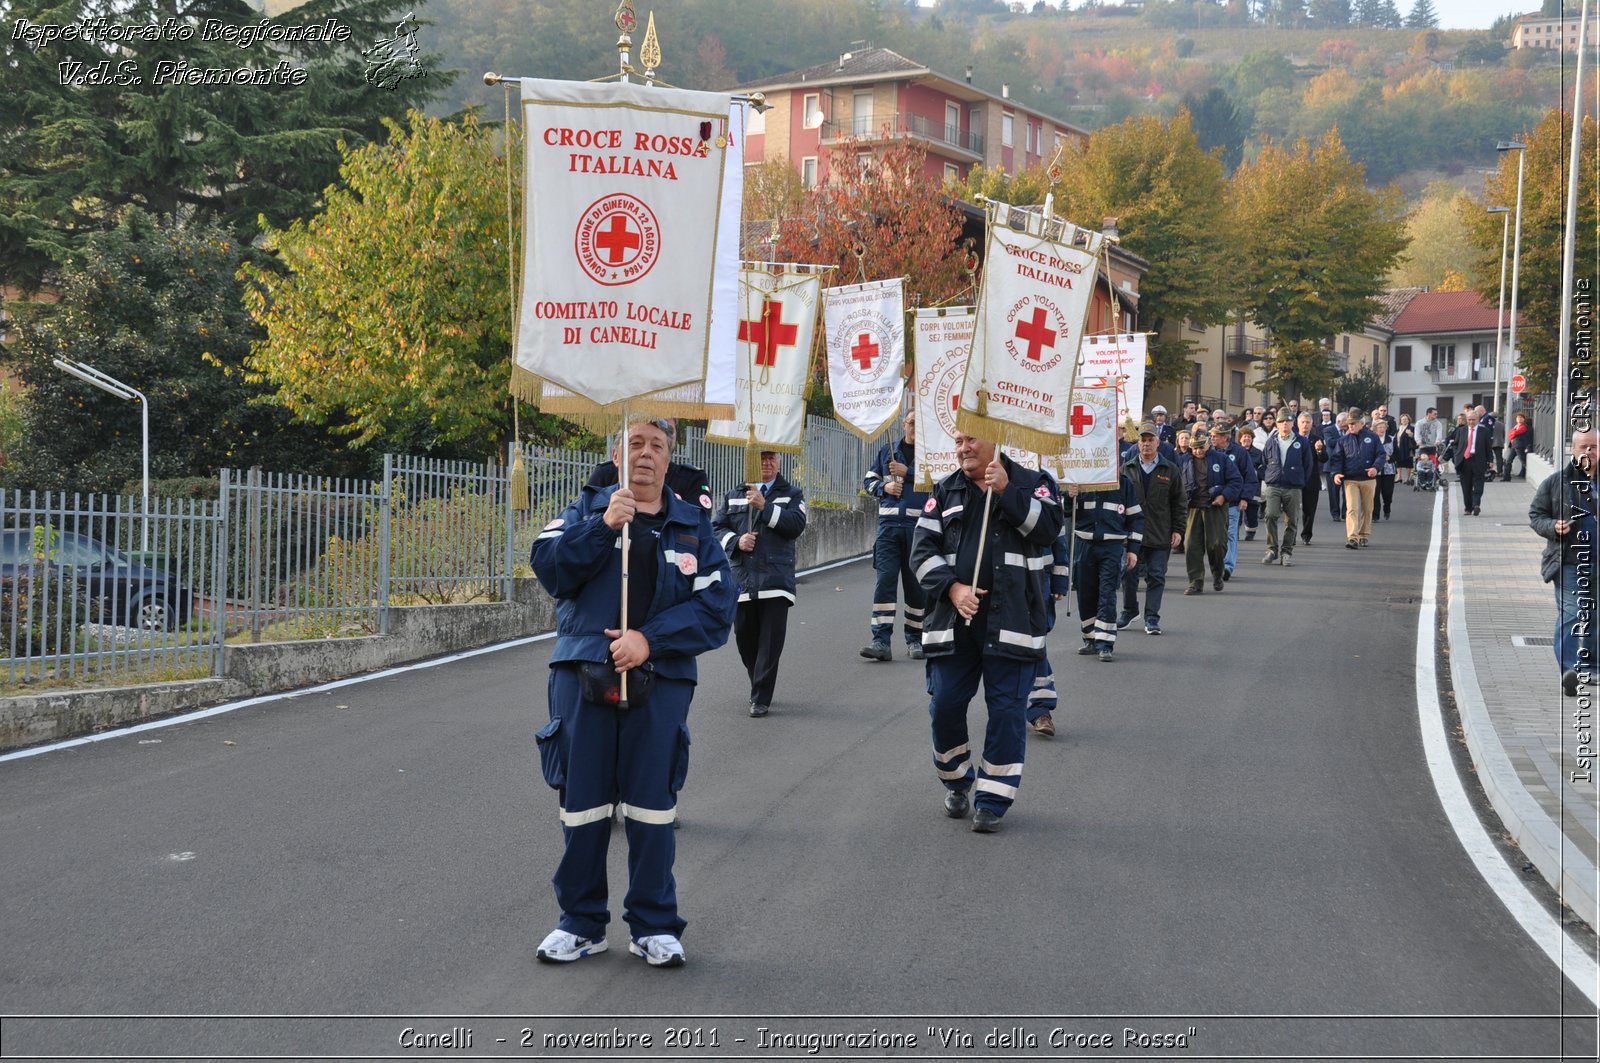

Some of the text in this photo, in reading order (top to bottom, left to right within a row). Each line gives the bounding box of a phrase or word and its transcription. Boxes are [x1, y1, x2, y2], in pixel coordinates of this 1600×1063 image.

[543, 128, 622, 149] CROCE
[634, 132, 708, 158] ROSSA
[569, 154, 678, 180] ITALIANA
[581, 199, 654, 277] CONVENZIONE DI GINEVRA 22 AGOSTO 1864
[1006, 244, 1082, 274] CROCE ROSS
[1017, 264, 1073, 289] ITALIANA
[535, 301, 692, 330] COMITATO LOCALE
[833, 308, 899, 349] CROCE ROSSA ITALIANA
[1007, 294, 1068, 338] CORPO VOLONTARI
[563, 326, 658, 349] DI CANELLI
[944, 332, 973, 340] FEMMIN
[919, 343, 970, 396] CROCE ROS
[1005, 340, 1061, 373] DEL SOCCORSO
[843, 387, 886, 398] DELEGAZIONE
[937, 370, 957, 435] NVENZIONE DI
[997, 380, 1053, 403] GRUPPO DI
[919, 463, 957, 473] BORGO
